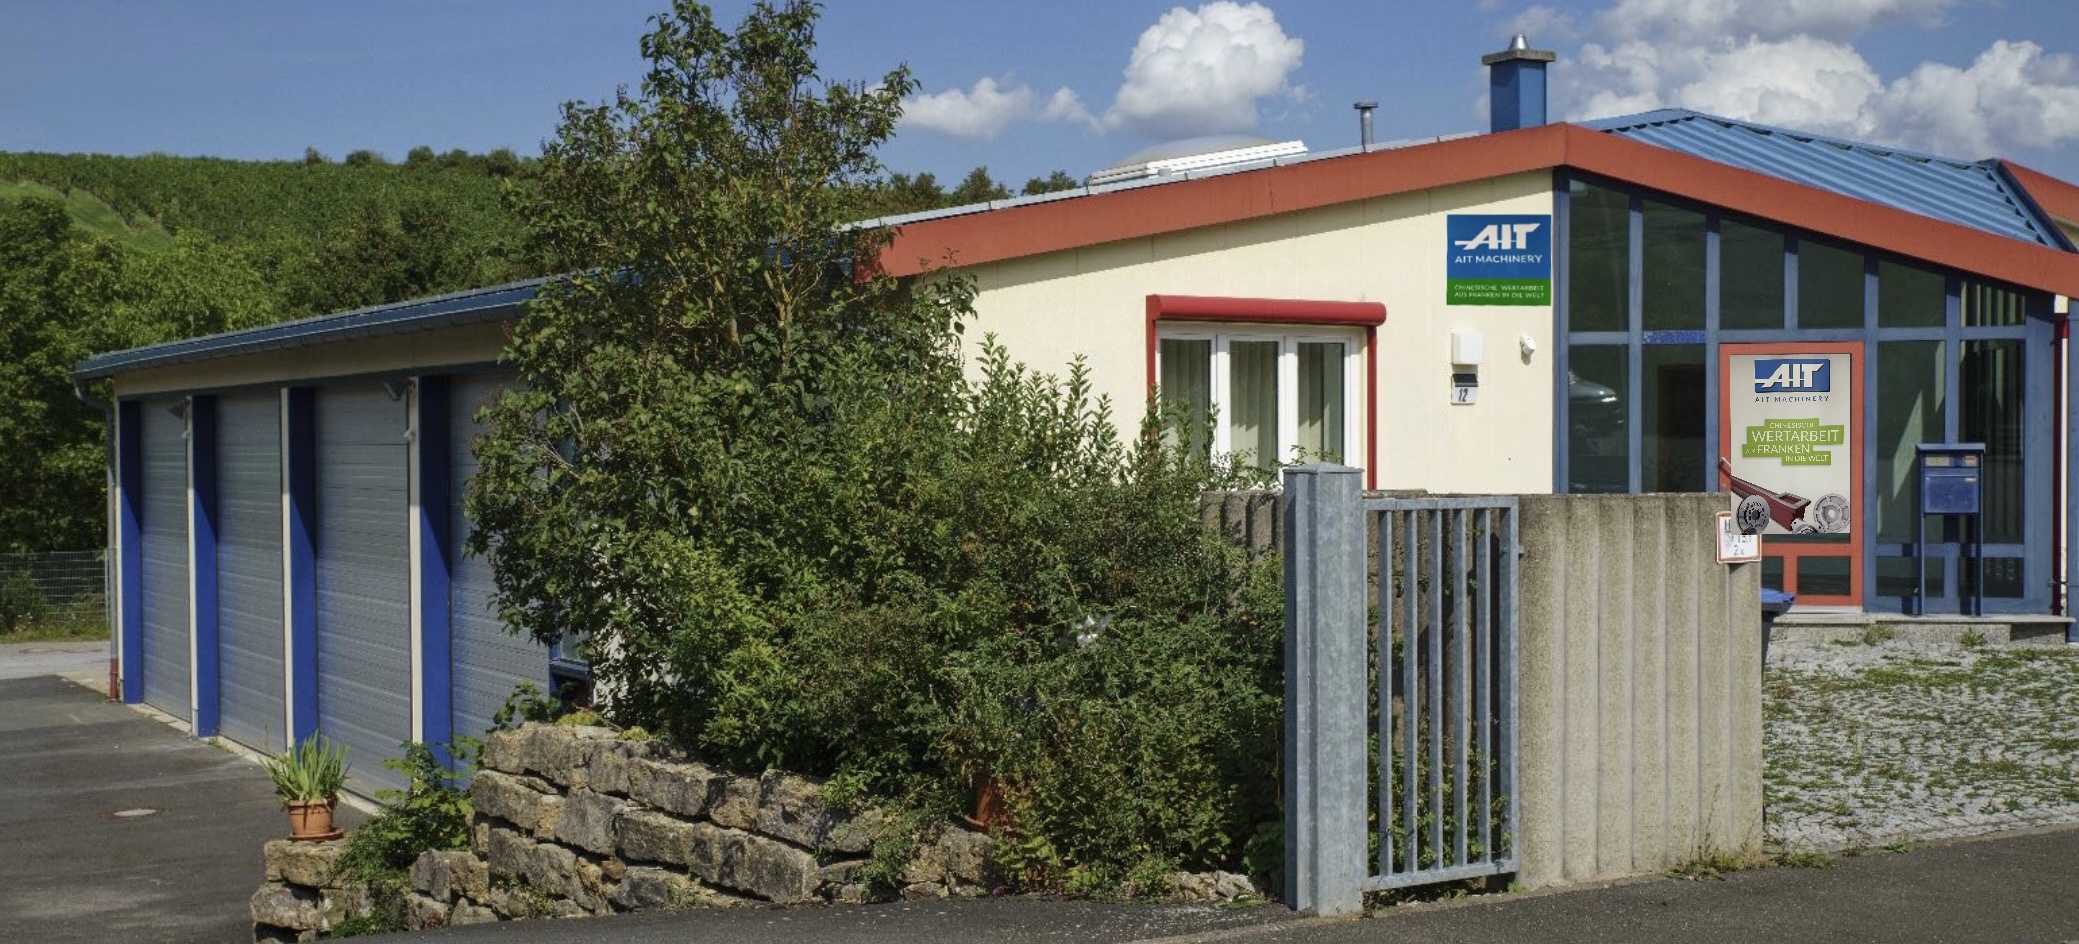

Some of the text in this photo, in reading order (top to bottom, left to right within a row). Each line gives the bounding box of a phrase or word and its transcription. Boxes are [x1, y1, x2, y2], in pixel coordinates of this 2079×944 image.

[1455, 223, 1541, 250] AIT
[1454, 254, 1543, 263] AIT MACHINERY
[1500, 284, 1545, 292] WERTARBEIT
[1468, 291, 1500, 299] FRANKEN
[1755, 363, 1825, 389] AIT
[1458, 387, 1468, 403] 12
[1774, 395, 1830, 403] MACHINERY
[1751, 429, 1840, 443] WERTARBEIT
[1757, 443, 1810, 454] FRANKEN
[1808, 454, 1829, 462] WELT
